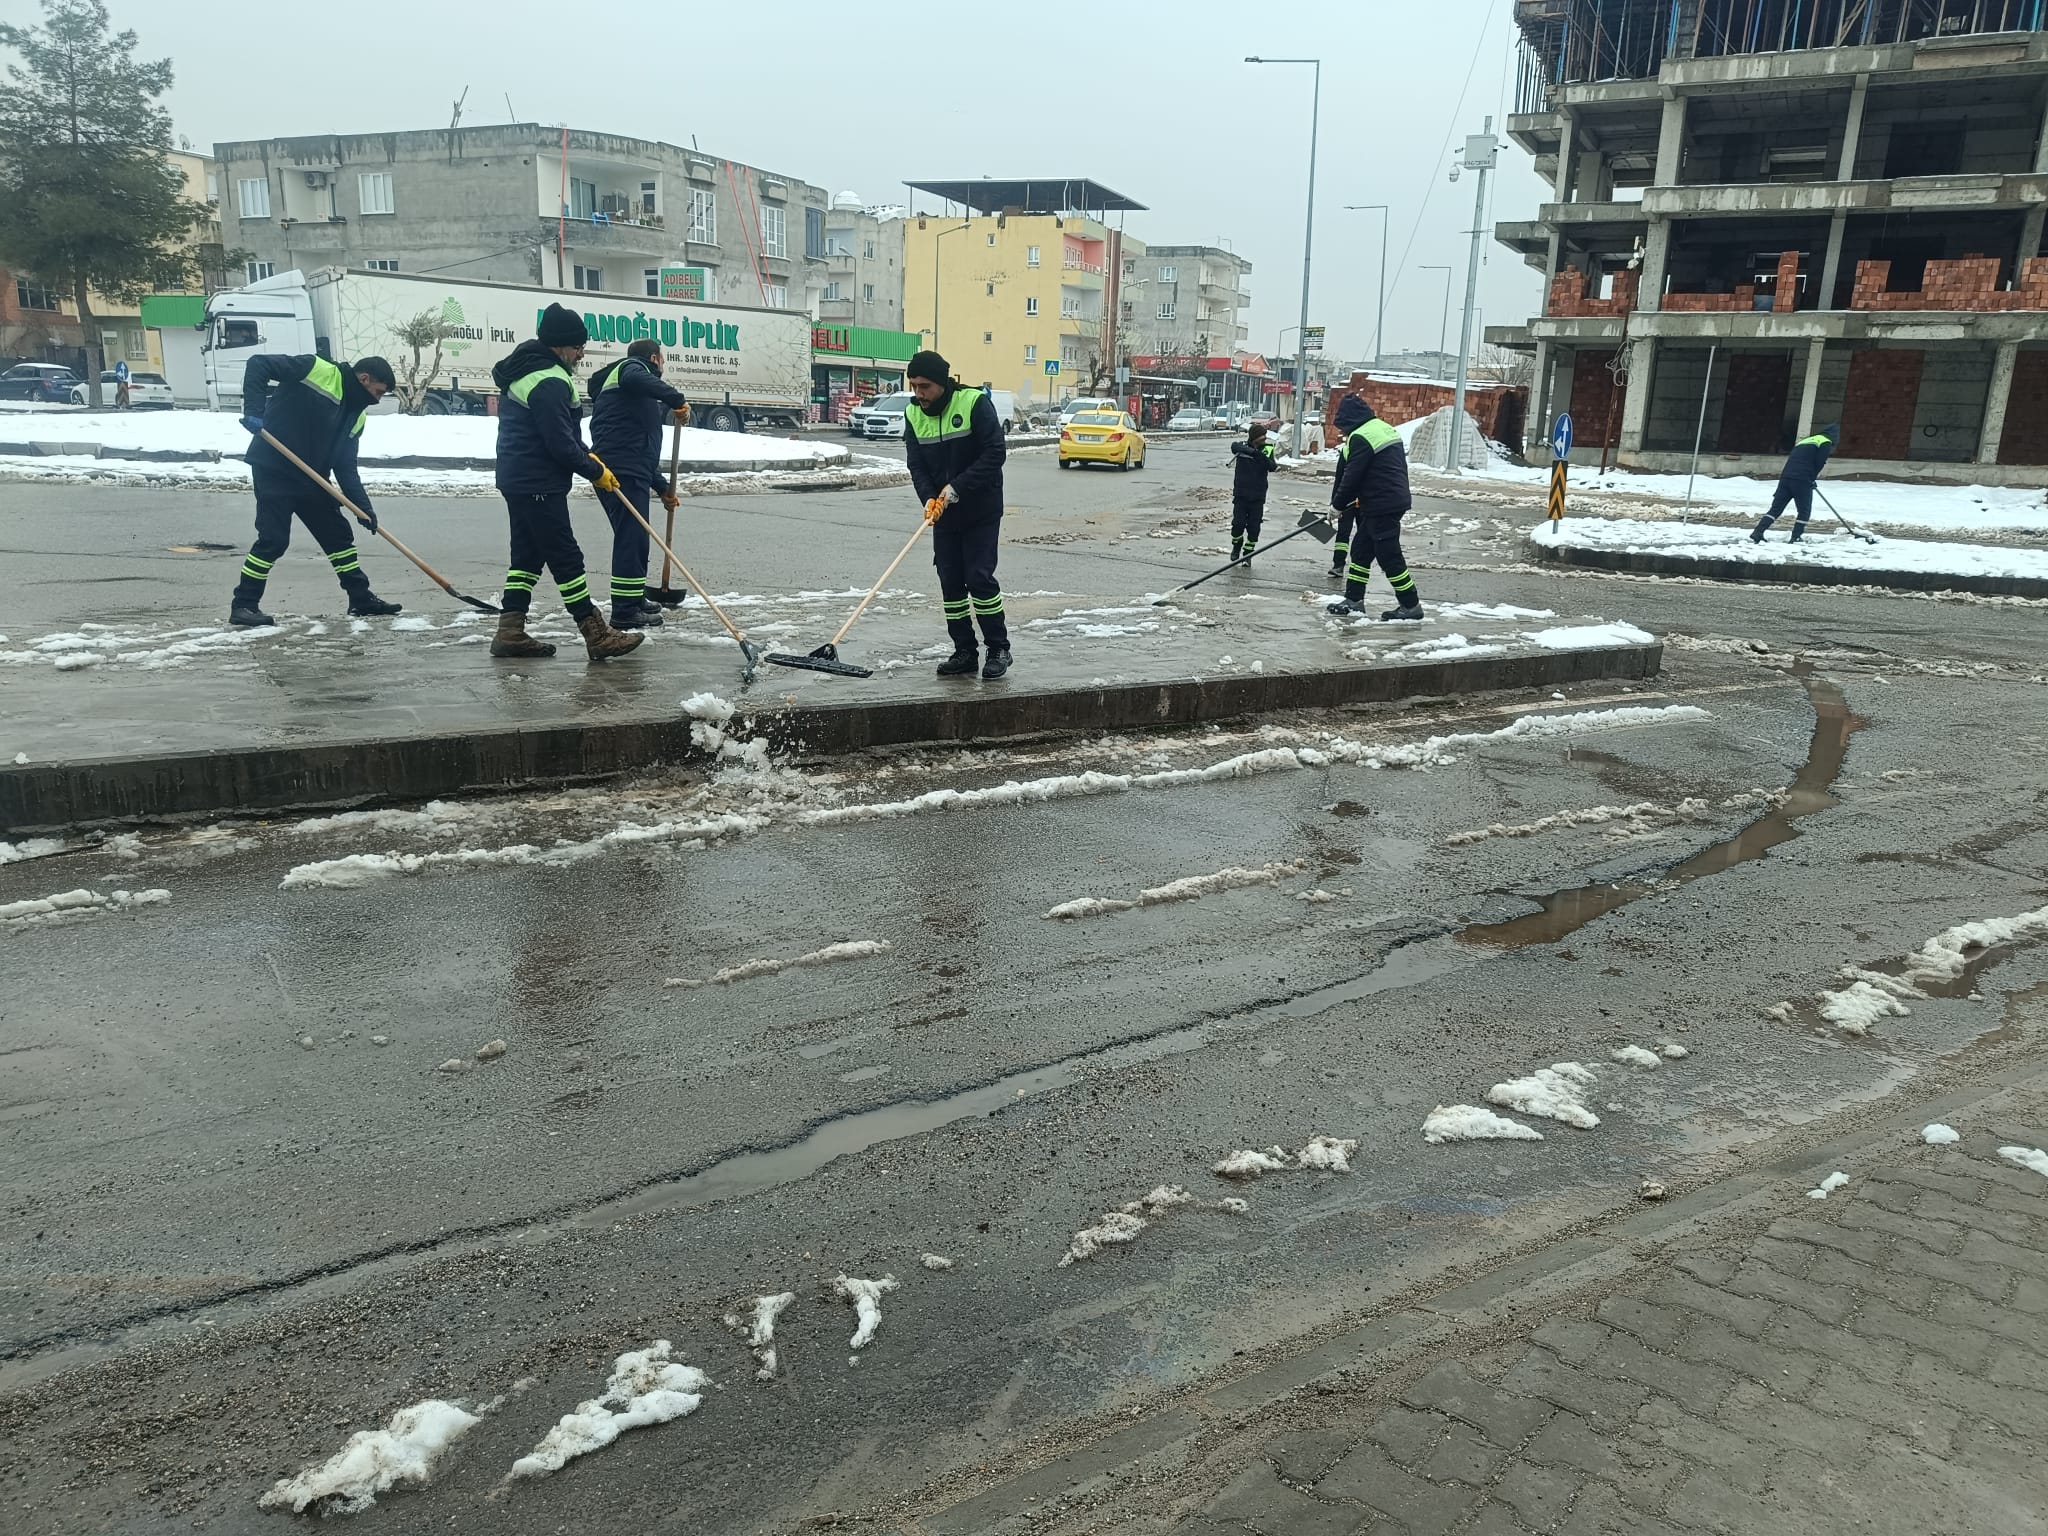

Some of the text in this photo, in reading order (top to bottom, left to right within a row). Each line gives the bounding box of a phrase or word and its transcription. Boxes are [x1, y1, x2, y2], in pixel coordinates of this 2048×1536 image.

[666, 288, 699, 300] MARKET
[490, 327, 515, 343] İPLİK
[682, 316, 740, 352] İPLİK
[667, 352, 741, 367] İHR. SAN VE TİC. AŞ.
